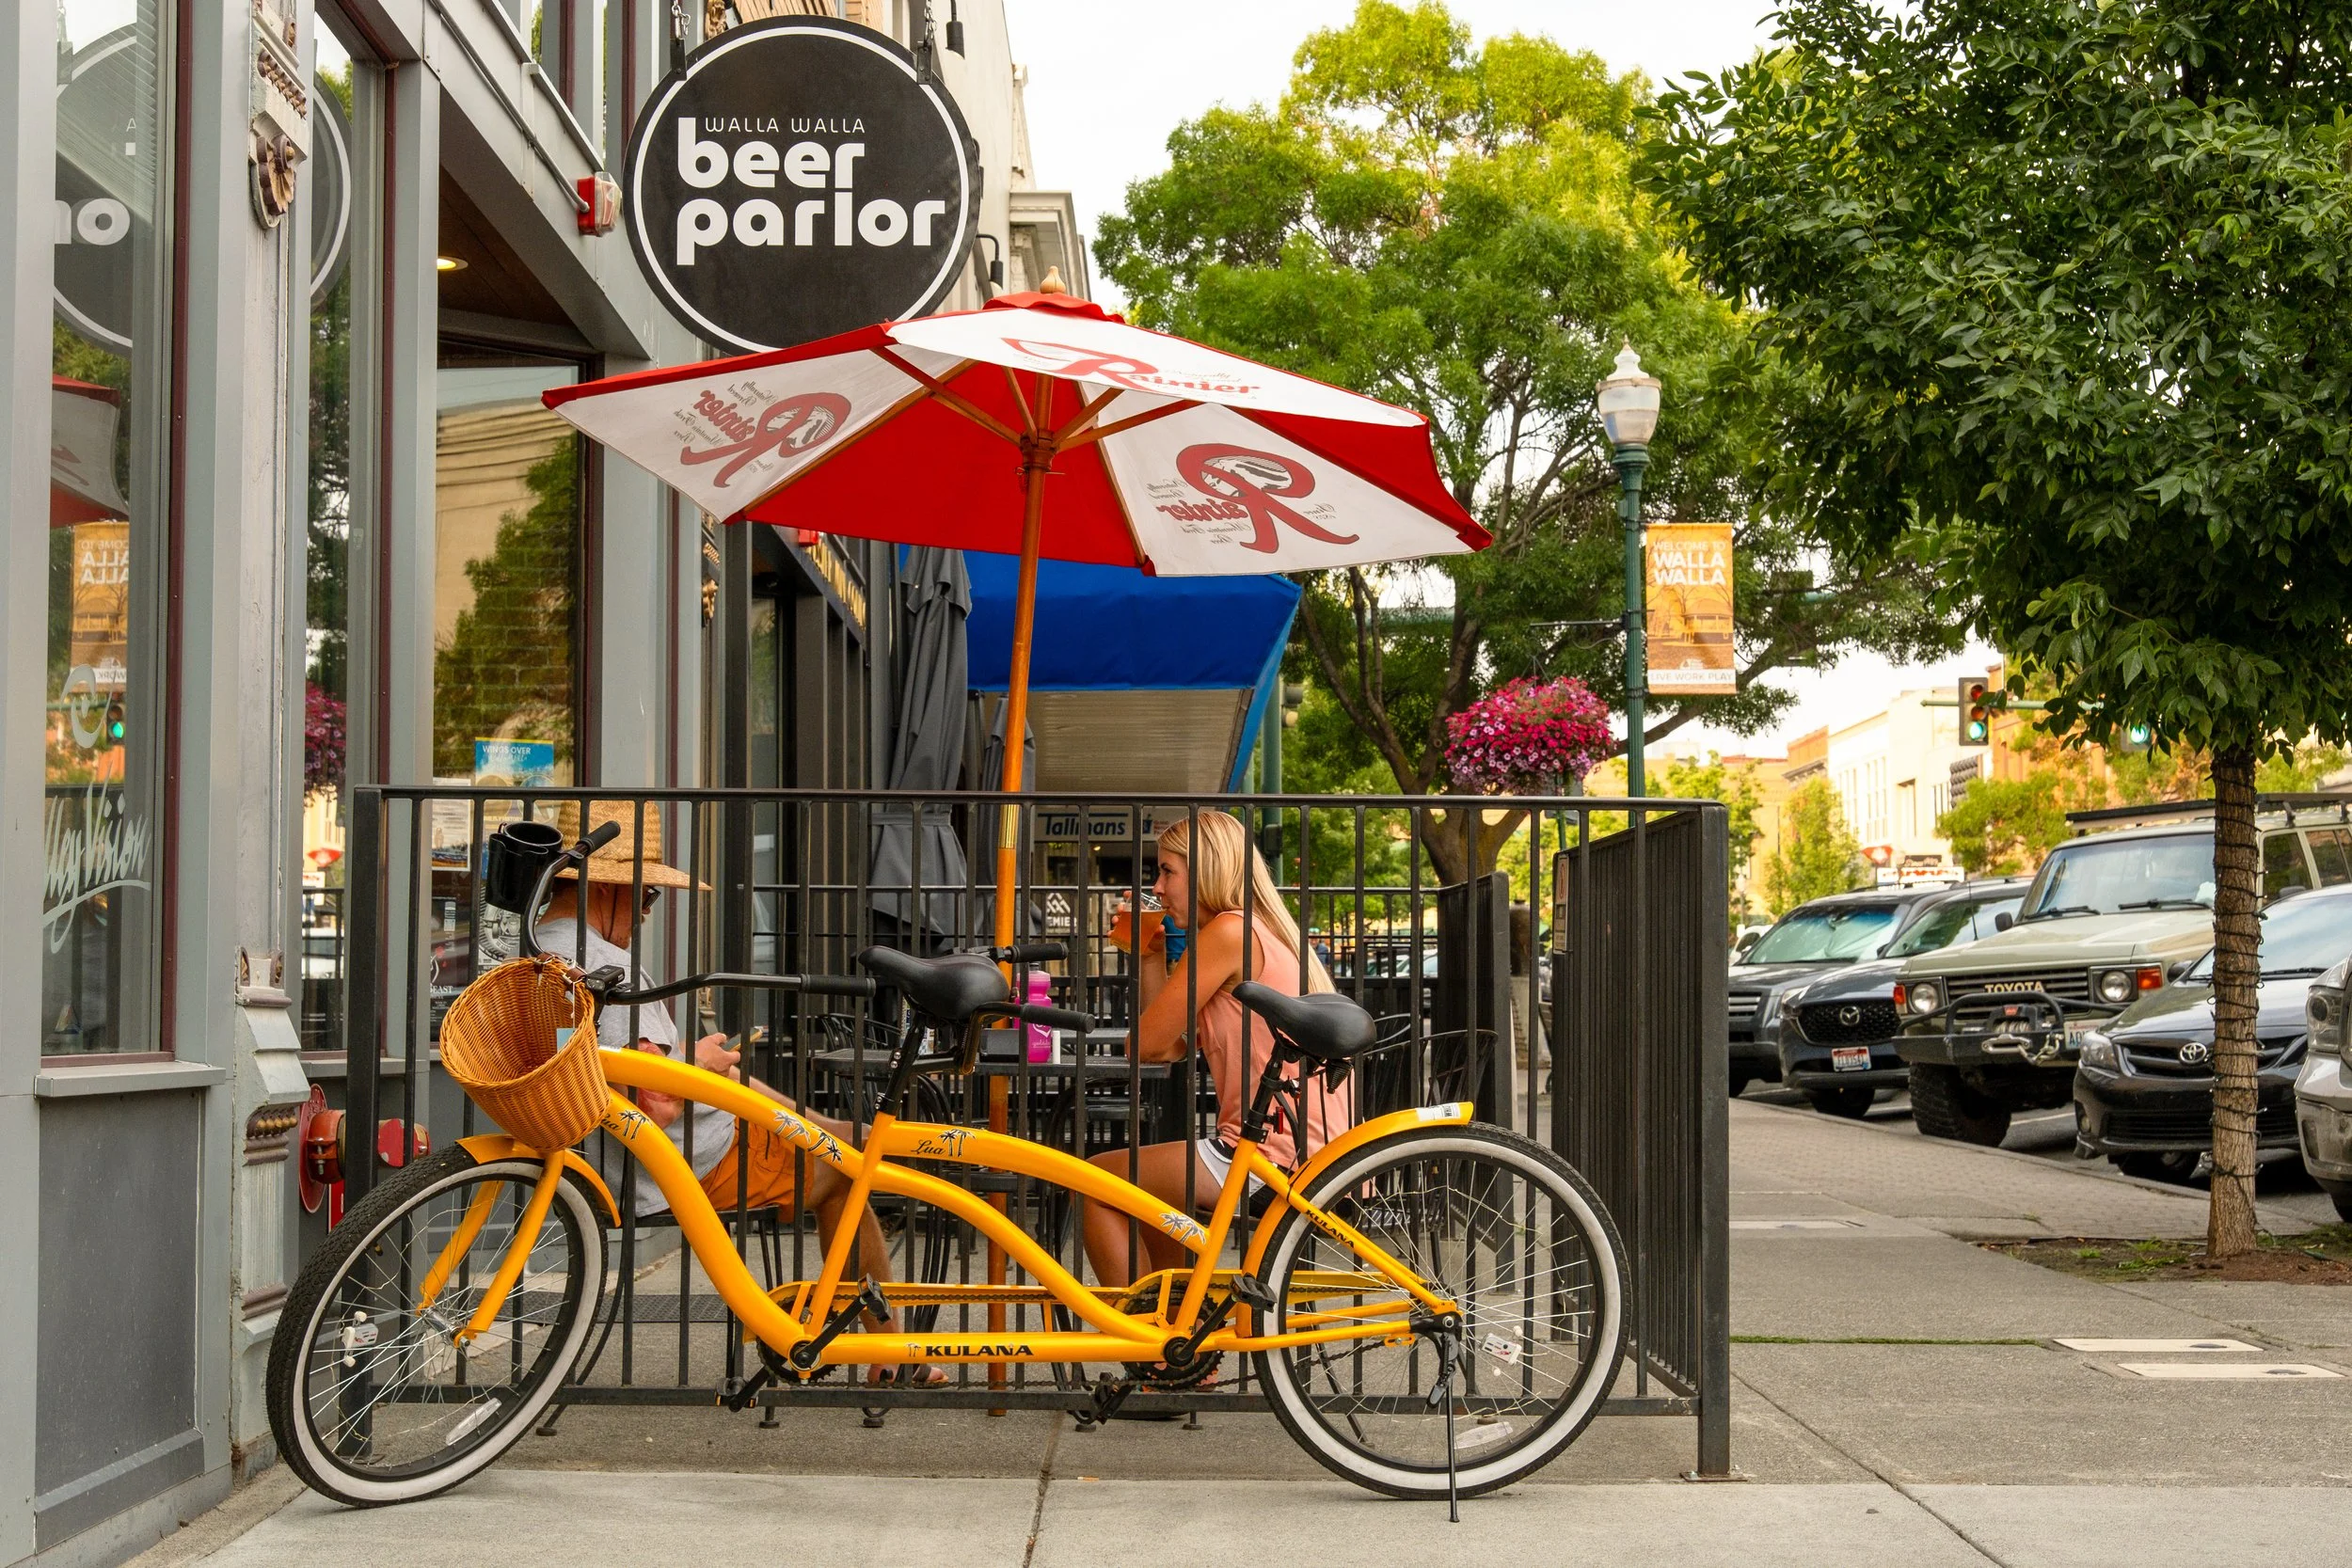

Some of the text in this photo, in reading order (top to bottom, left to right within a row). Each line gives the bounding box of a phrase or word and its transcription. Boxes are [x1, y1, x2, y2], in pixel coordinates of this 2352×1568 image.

[706, 118, 866, 134] WALLA WALLA
[677, 117, 866, 189] beer
[676, 192, 946, 265] parlor
[1653, 541, 1726, 552] WELCOME TO
[1653, 551, 1726, 568] WALLA
[1654, 568, 1726, 585] WALLA
[1650, 671, 1733, 681] LIVE WORK PLAY
[482, 744, 532, 754] WINGS OVER
[1985, 981, 2045, 993] TOYOTA
[911, 1139, 946, 1155] Lua
[1306, 1210, 1355, 1249] KULANA
[926, 1343, 1033, 1356] KULANA
